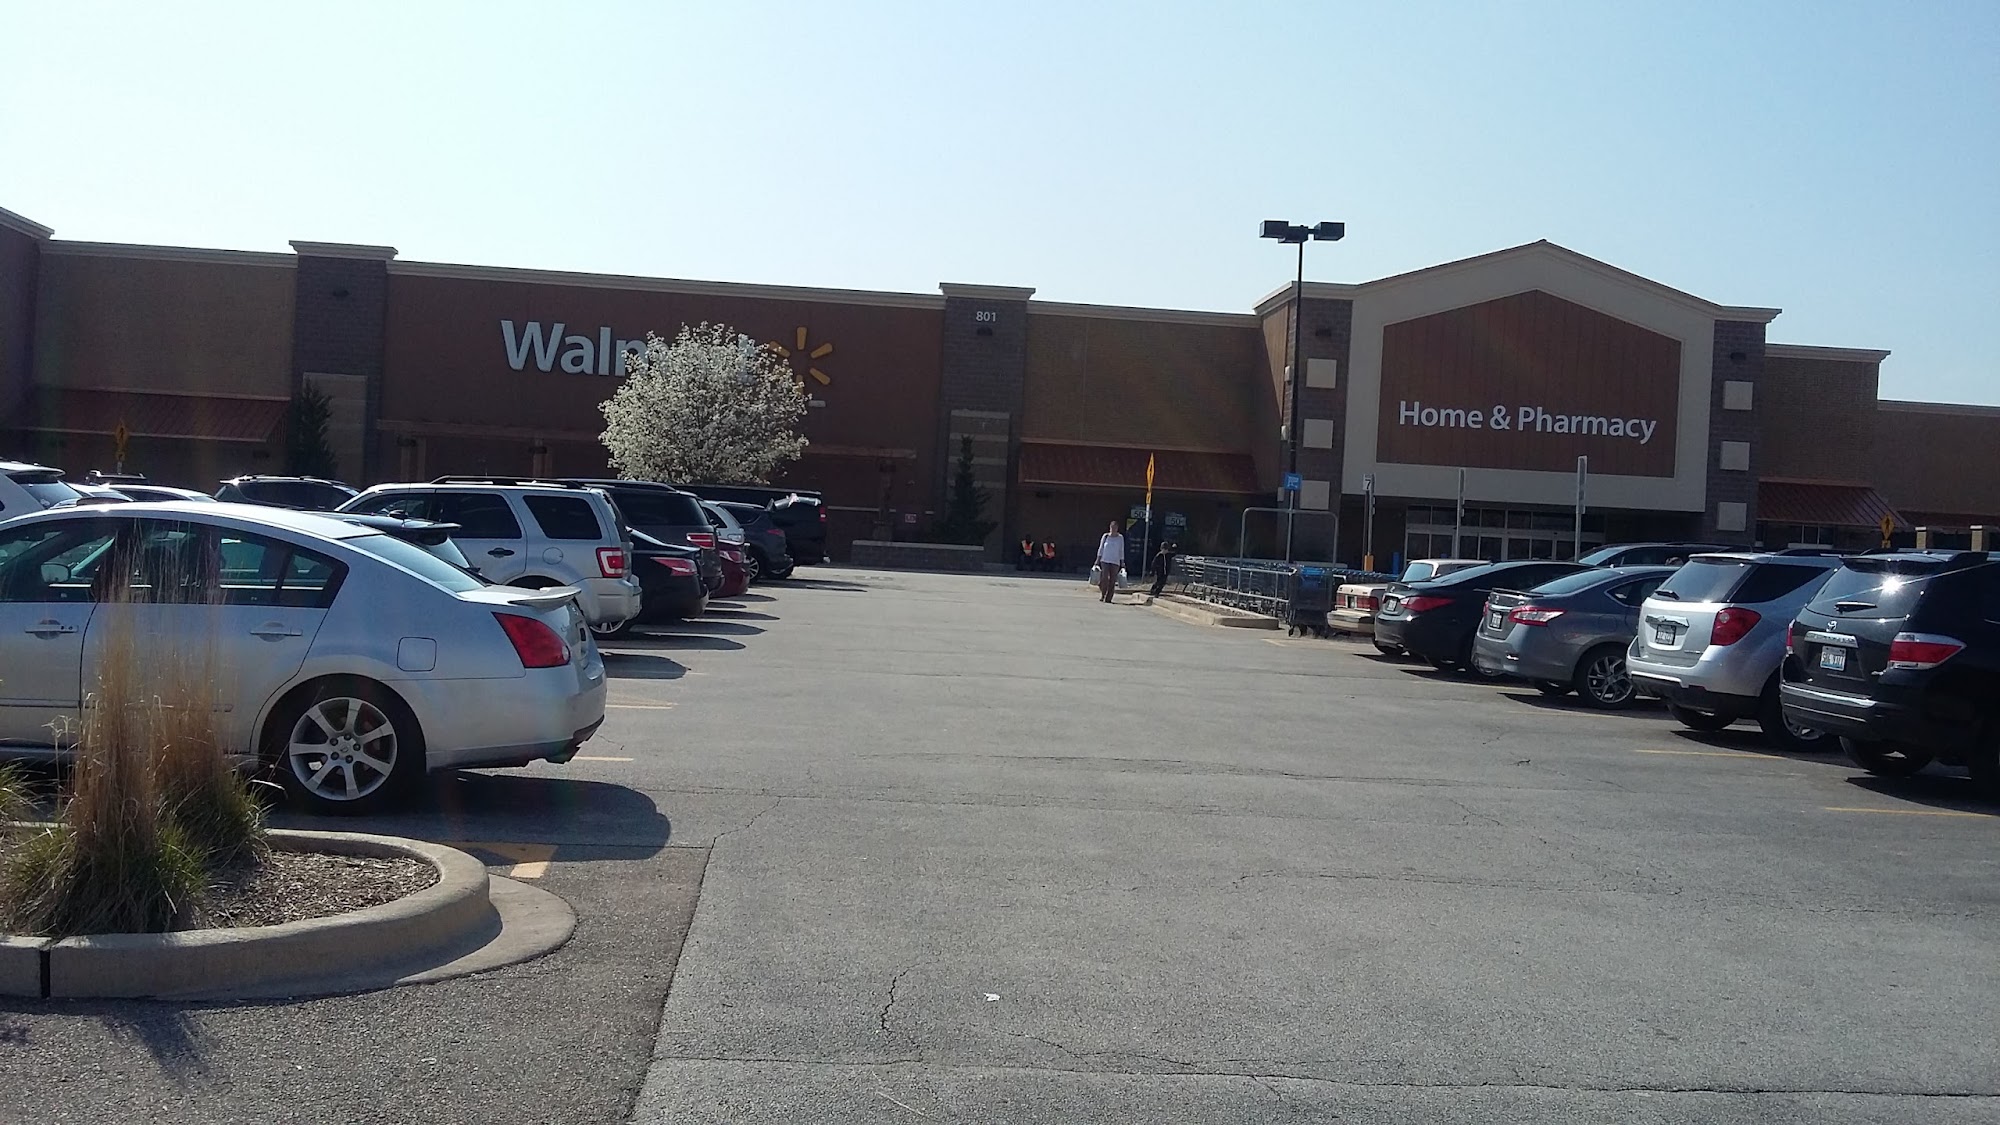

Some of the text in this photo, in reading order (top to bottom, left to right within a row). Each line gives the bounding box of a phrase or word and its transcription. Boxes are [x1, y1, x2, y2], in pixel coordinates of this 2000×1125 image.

[975, 310, 997, 322] 801
[1399, 400, 1657, 445] Home & Pharmacy
